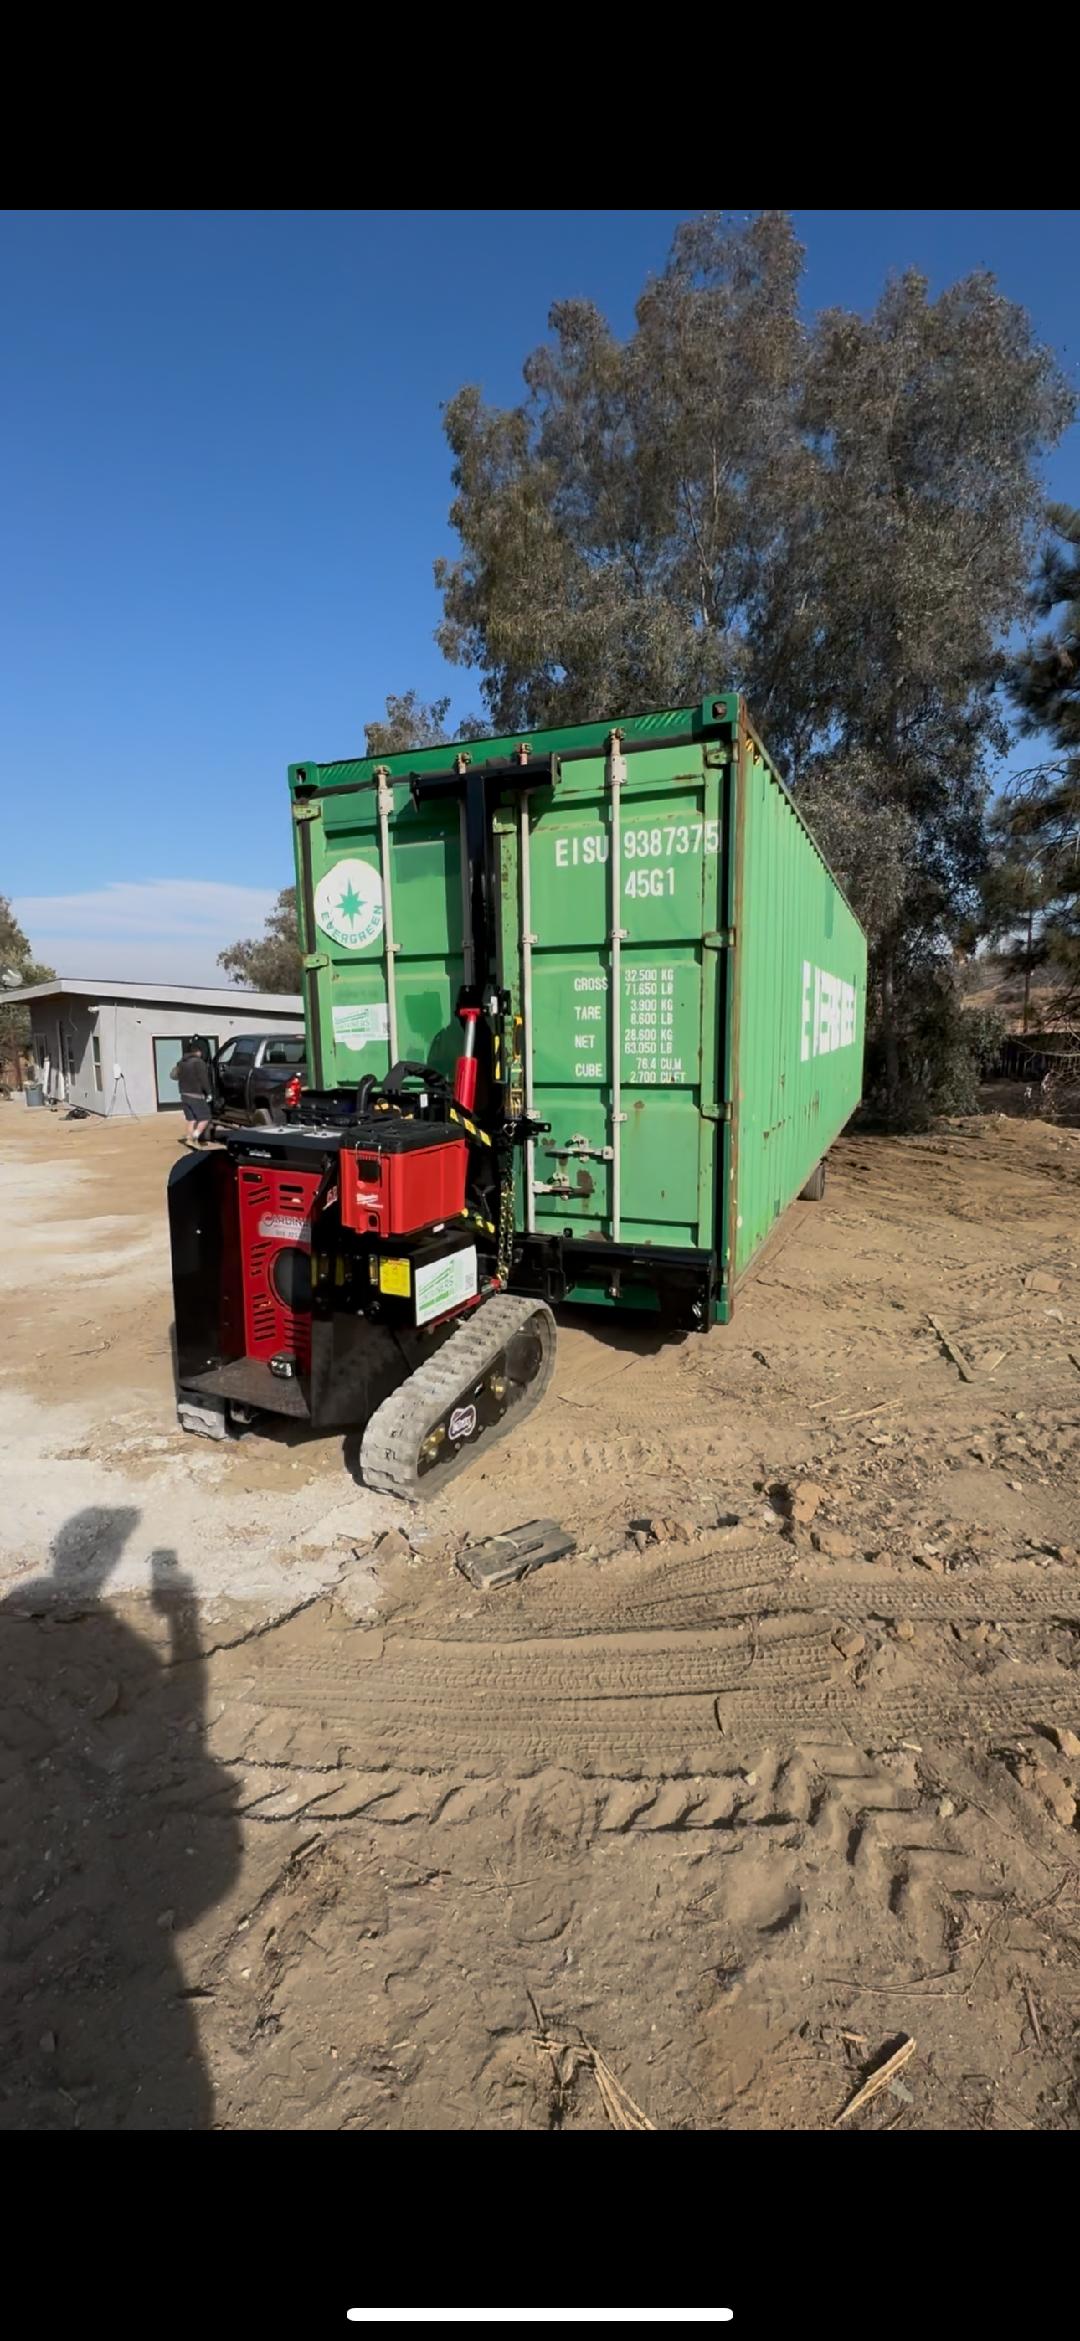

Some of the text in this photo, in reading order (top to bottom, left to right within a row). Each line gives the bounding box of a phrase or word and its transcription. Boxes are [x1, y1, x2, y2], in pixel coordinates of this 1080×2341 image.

[555, 820, 722, 867] EISU 9387375
[624, 867, 675, 899] 45G1
[320, 904, 384, 945] EVERGREEN
[624, 969, 674, 982] 32.500 KG
[574, 976, 609, 991] GROSS
[625, 982, 674, 996] 71.650 LB
[573, 1005, 602, 1020] TARE
[630, 999, 673, 1012] 3.900 KG
[660, 1012, 673, 1025] LB
[574, 1034, 596, 1048] NET
[660, 1028, 673, 1041] KG
[660, 1041, 673, 1054] LB
[575, 1063, 603, 1077] CUBE
[660, 1071, 687, 1084] CUFT
[263, 1211, 309, 1228] CARDIN
